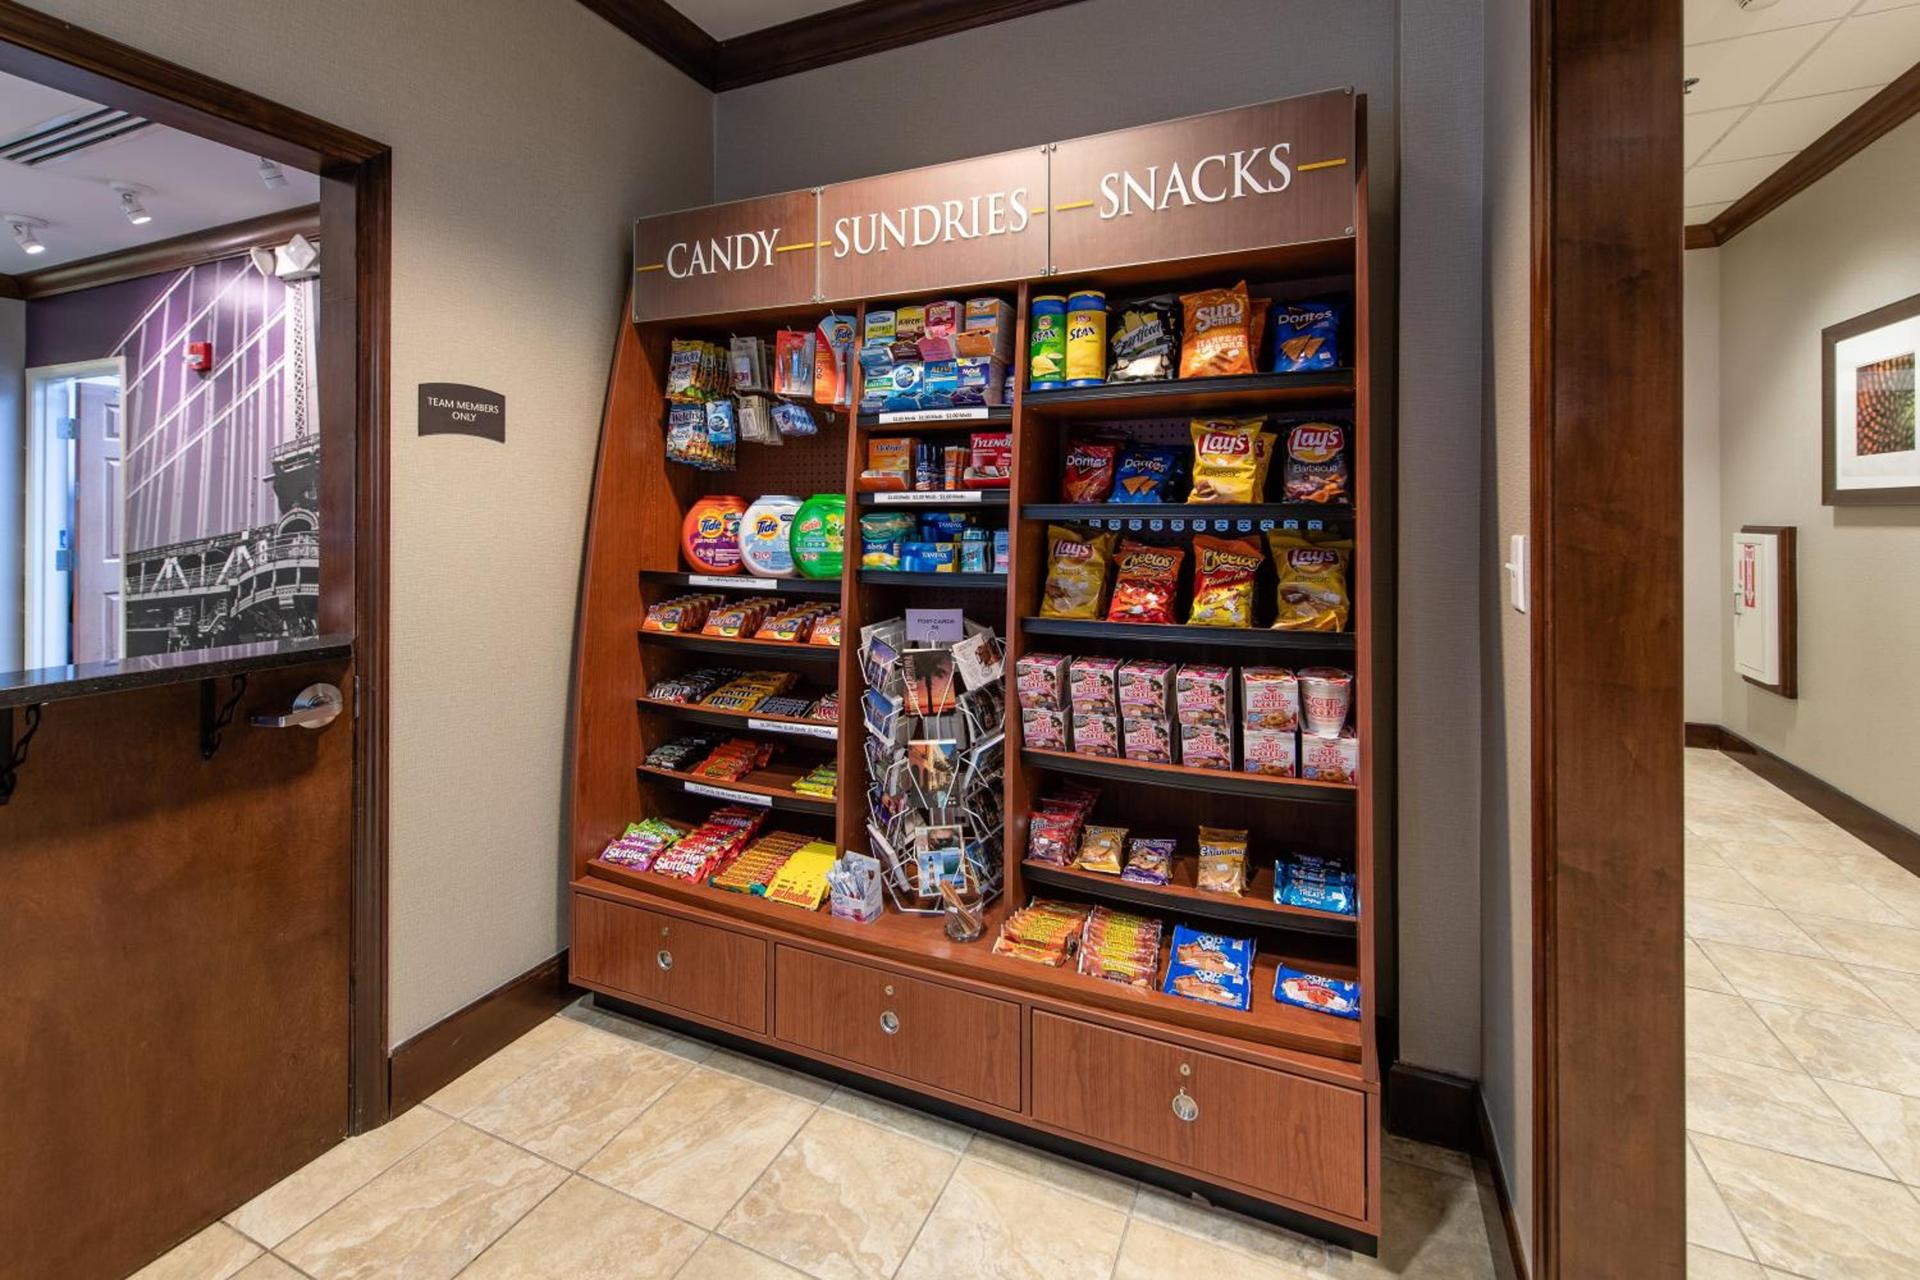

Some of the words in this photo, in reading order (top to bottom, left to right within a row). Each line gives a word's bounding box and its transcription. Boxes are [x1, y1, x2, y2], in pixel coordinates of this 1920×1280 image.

[1100, 143, 1292, 219] SNACKS
[834, 188, 1029, 258] SUNDRIES
[667, 228, 781, 278] CANDY
[1278, 310, 1333, 324] Doritos
[426, 396, 454, 409] TEAM
[456, 401, 499, 414] MEMBERS
[452, 411, 477, 422] ONLY
[1201, 433, 1247, 453] Lay's
[1292, 429, 1340, 449] Lay's
[1067, 455, 1107, 467] Doritos
[1124, 459, 1167, 473] Doritos
[1294, 464, 1337, 473] Barbecue
[700, 520, 721, 532] Tide
[757, 521, 778, 535] Tide
[921, 551, 949, 559] TAMPAX
[1055, 540, 1091, 558] Lay's
[1292, 549, 1335, 565] Lay's
[1121, 553, 1174, 570] Cheetos
[606, 846, 649, 861] Skittles
[653, 856, 698, 876] Skittles
